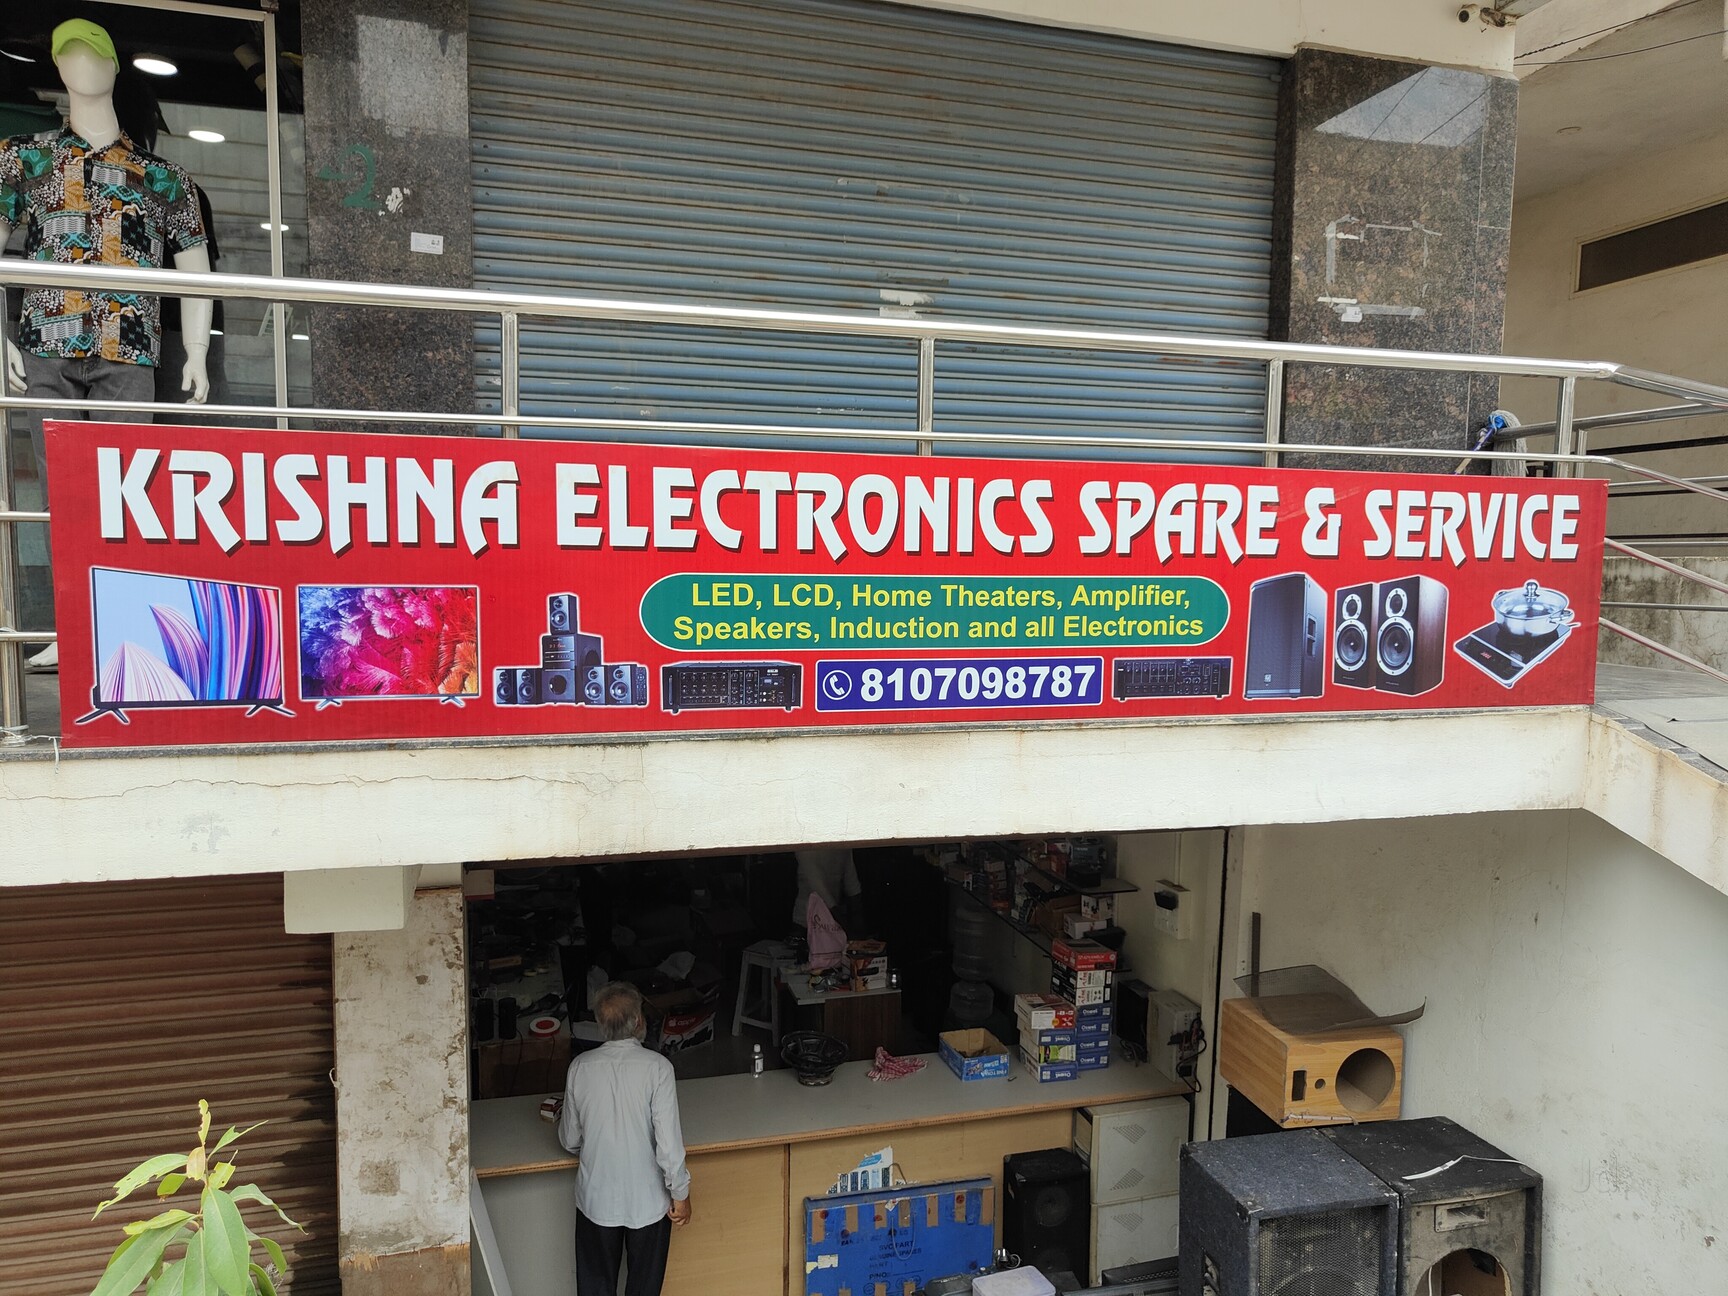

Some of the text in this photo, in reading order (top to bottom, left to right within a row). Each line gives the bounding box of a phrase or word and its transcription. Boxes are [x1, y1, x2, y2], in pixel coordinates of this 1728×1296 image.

[97, 446, 1580, 567] KRISHNA ELECTRONICS SPARE & SERVICE
[692, 583, 1191, 611] LED, LCD, Home Theaters, Amplifier,
[674, 615, 1203, 645] Speakers, Induction and all Electronics
[860, 665, 1096, 702] 8107098787
